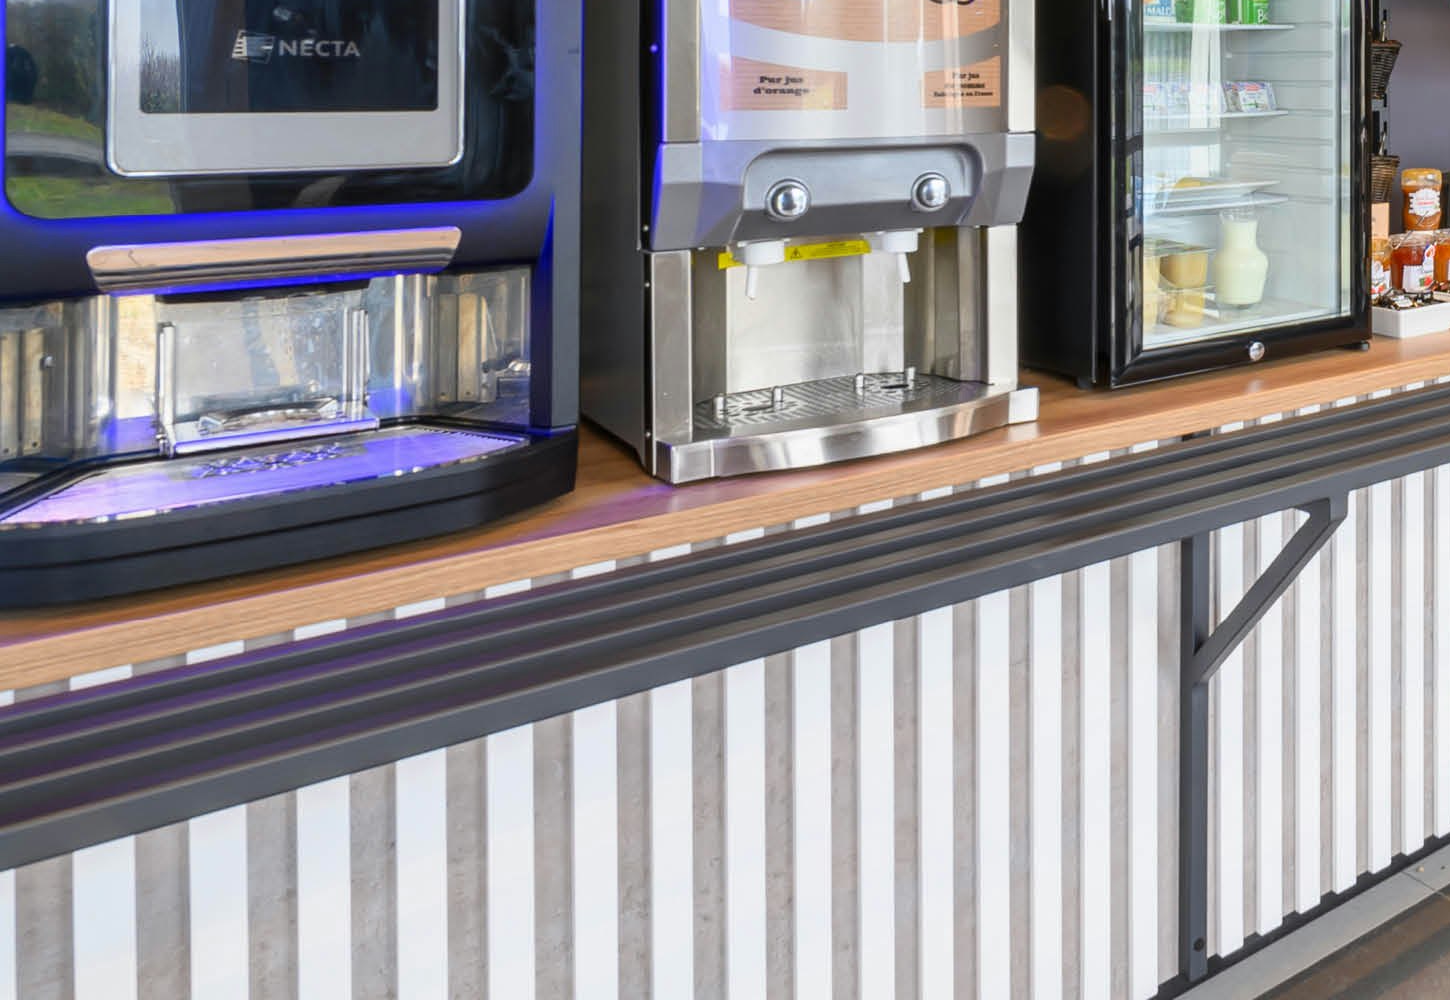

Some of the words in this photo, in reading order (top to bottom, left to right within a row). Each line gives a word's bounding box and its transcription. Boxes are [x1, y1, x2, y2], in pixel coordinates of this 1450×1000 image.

[278, 38, 361, 58] NECTA
[759, 75, 782, 83] Pur
[783, 75, 803, 85] jus
